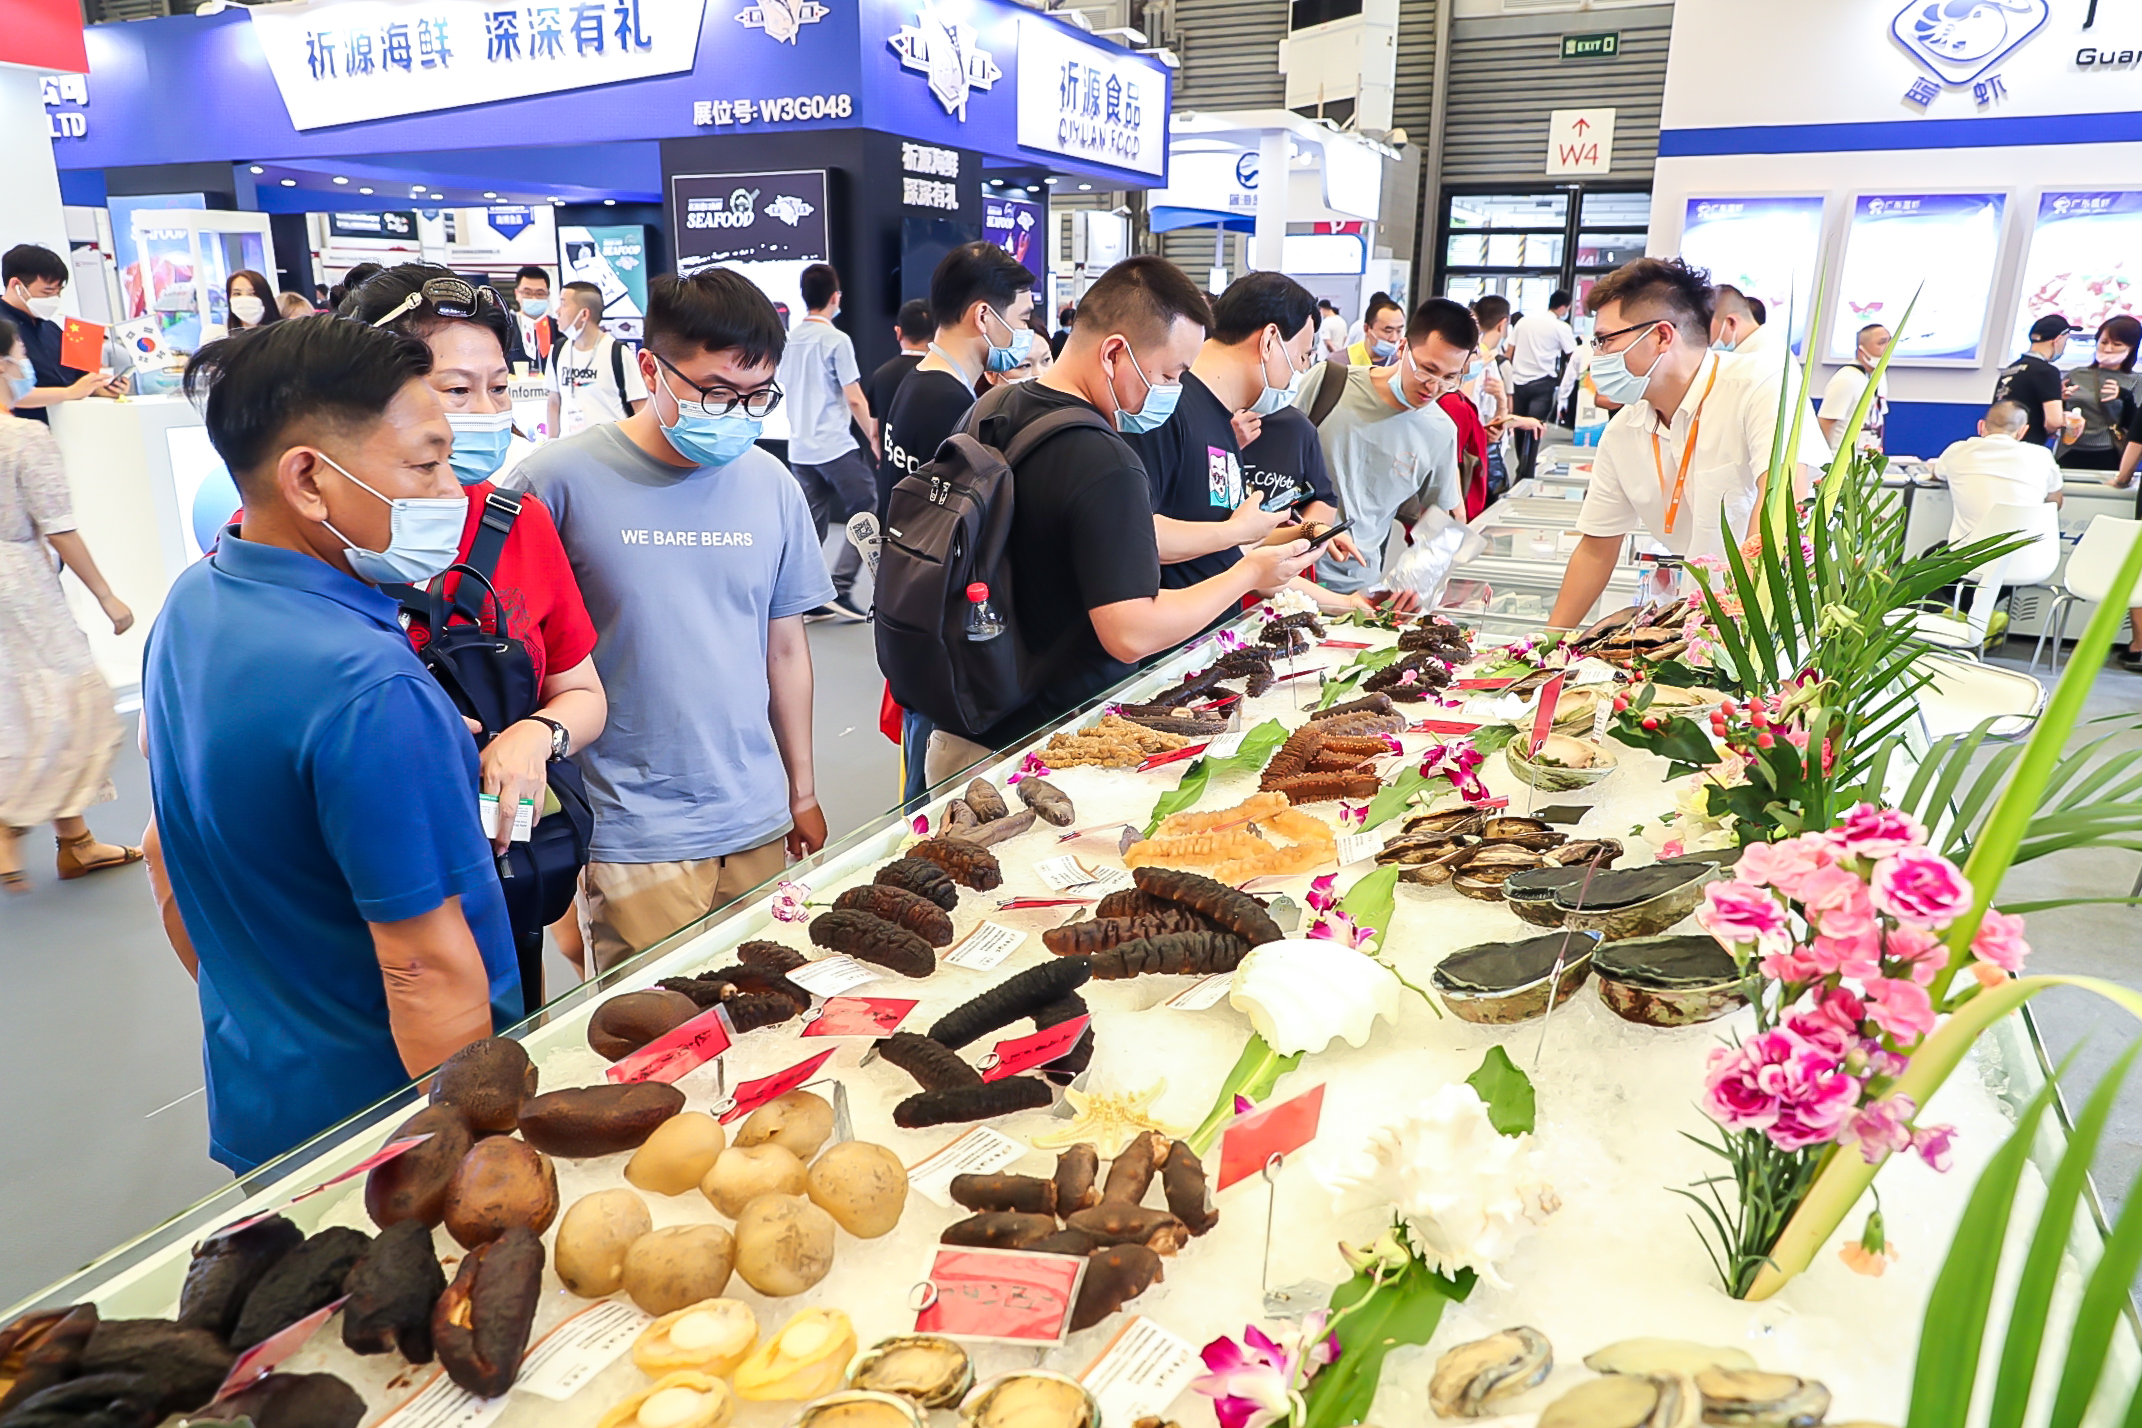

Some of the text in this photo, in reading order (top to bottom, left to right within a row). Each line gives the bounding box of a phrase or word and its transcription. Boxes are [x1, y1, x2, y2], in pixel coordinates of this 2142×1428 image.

[306, 0, 653, 80] 祈源海鲜 深深有礼
[1060, 58, 1141, 132] 祈源食品
[46, 112, 88, 137] LTD
[1058, 117, 1140, 157] QIYUAN FOOD
[1558, 142, 1600, 167] W4
[686, 210, 756, 229] SEAFOOD
[621, 529, 753, 547] WE BARE BEARS
